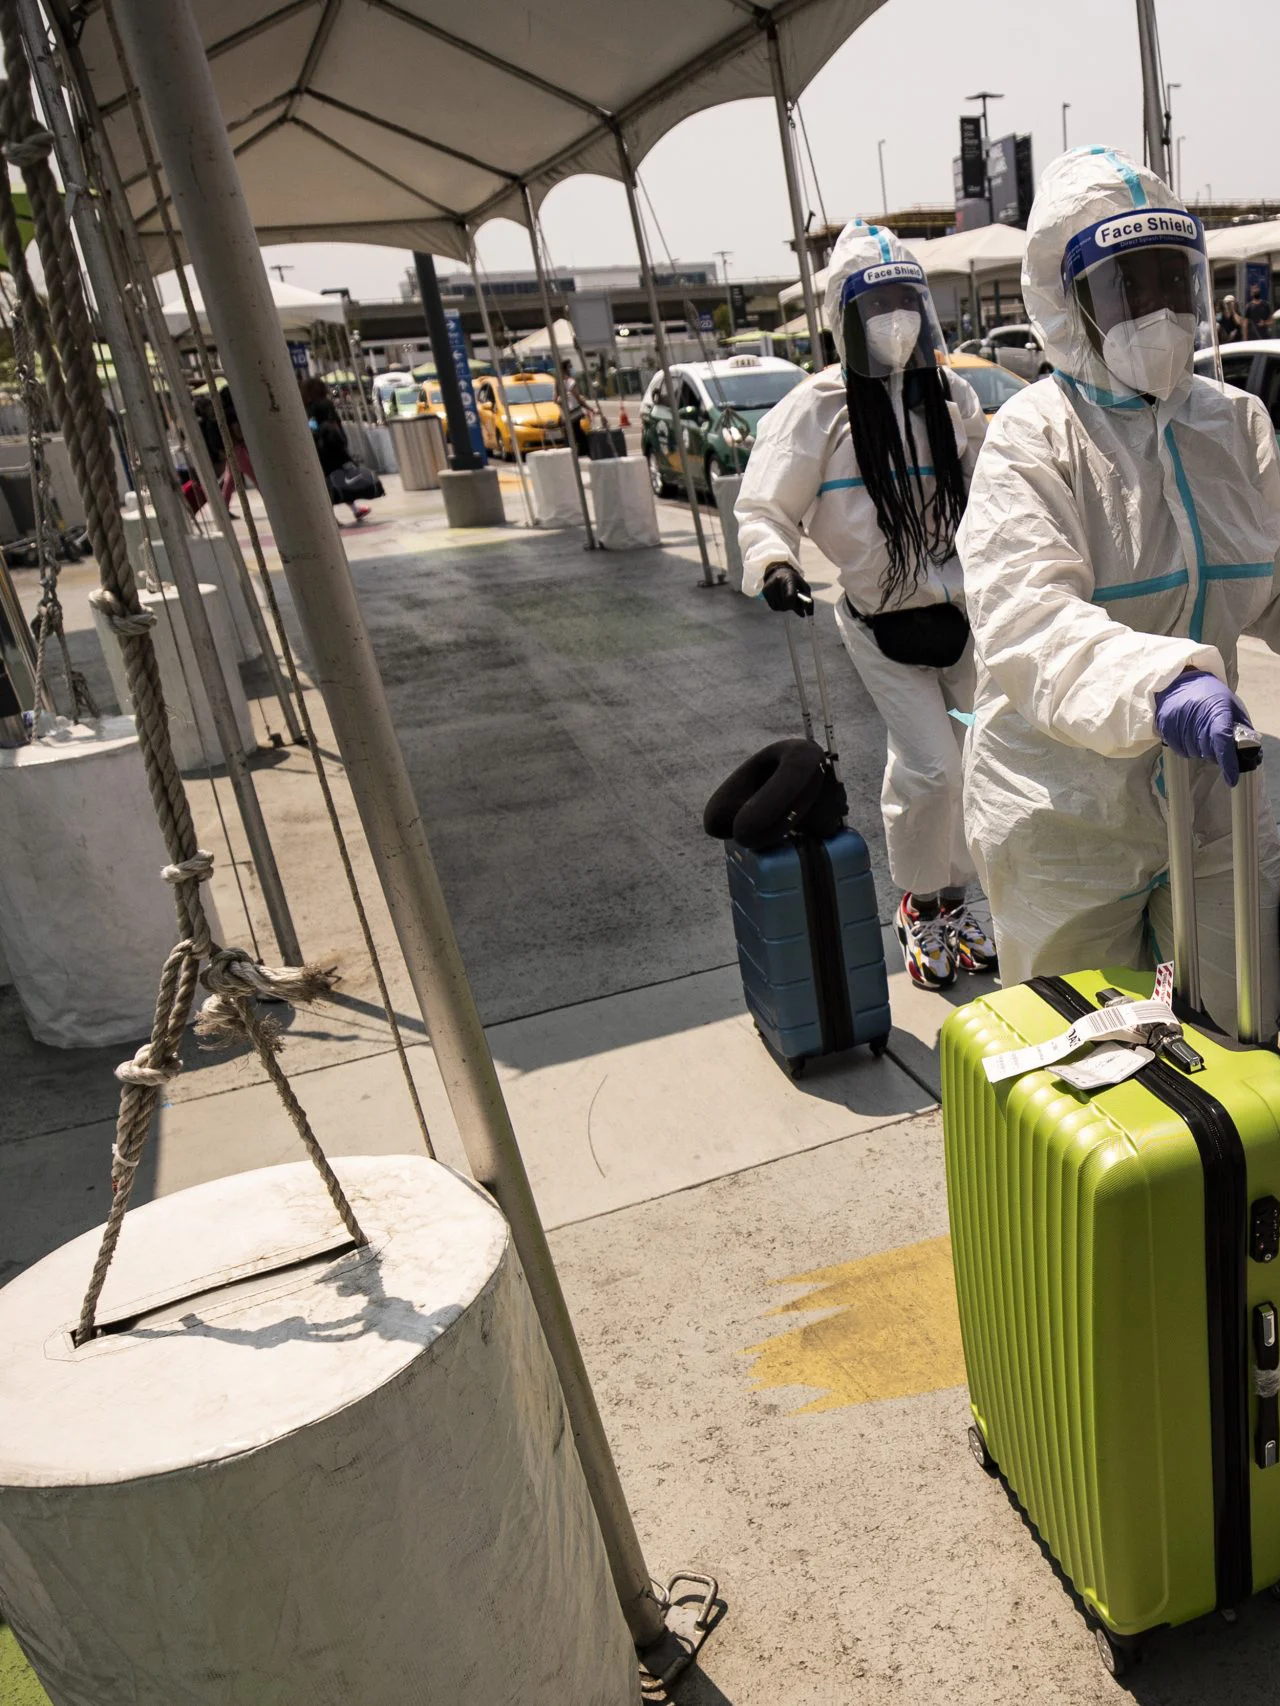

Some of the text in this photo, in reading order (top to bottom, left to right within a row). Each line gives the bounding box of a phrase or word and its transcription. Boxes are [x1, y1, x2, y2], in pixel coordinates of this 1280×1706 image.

[1101, 217, 1194, 243] Face Shield
[1120, 238, 1139, 248] Direct
[867, 268, 892, 281] Face
[894, 266, 921, 277] Shield
